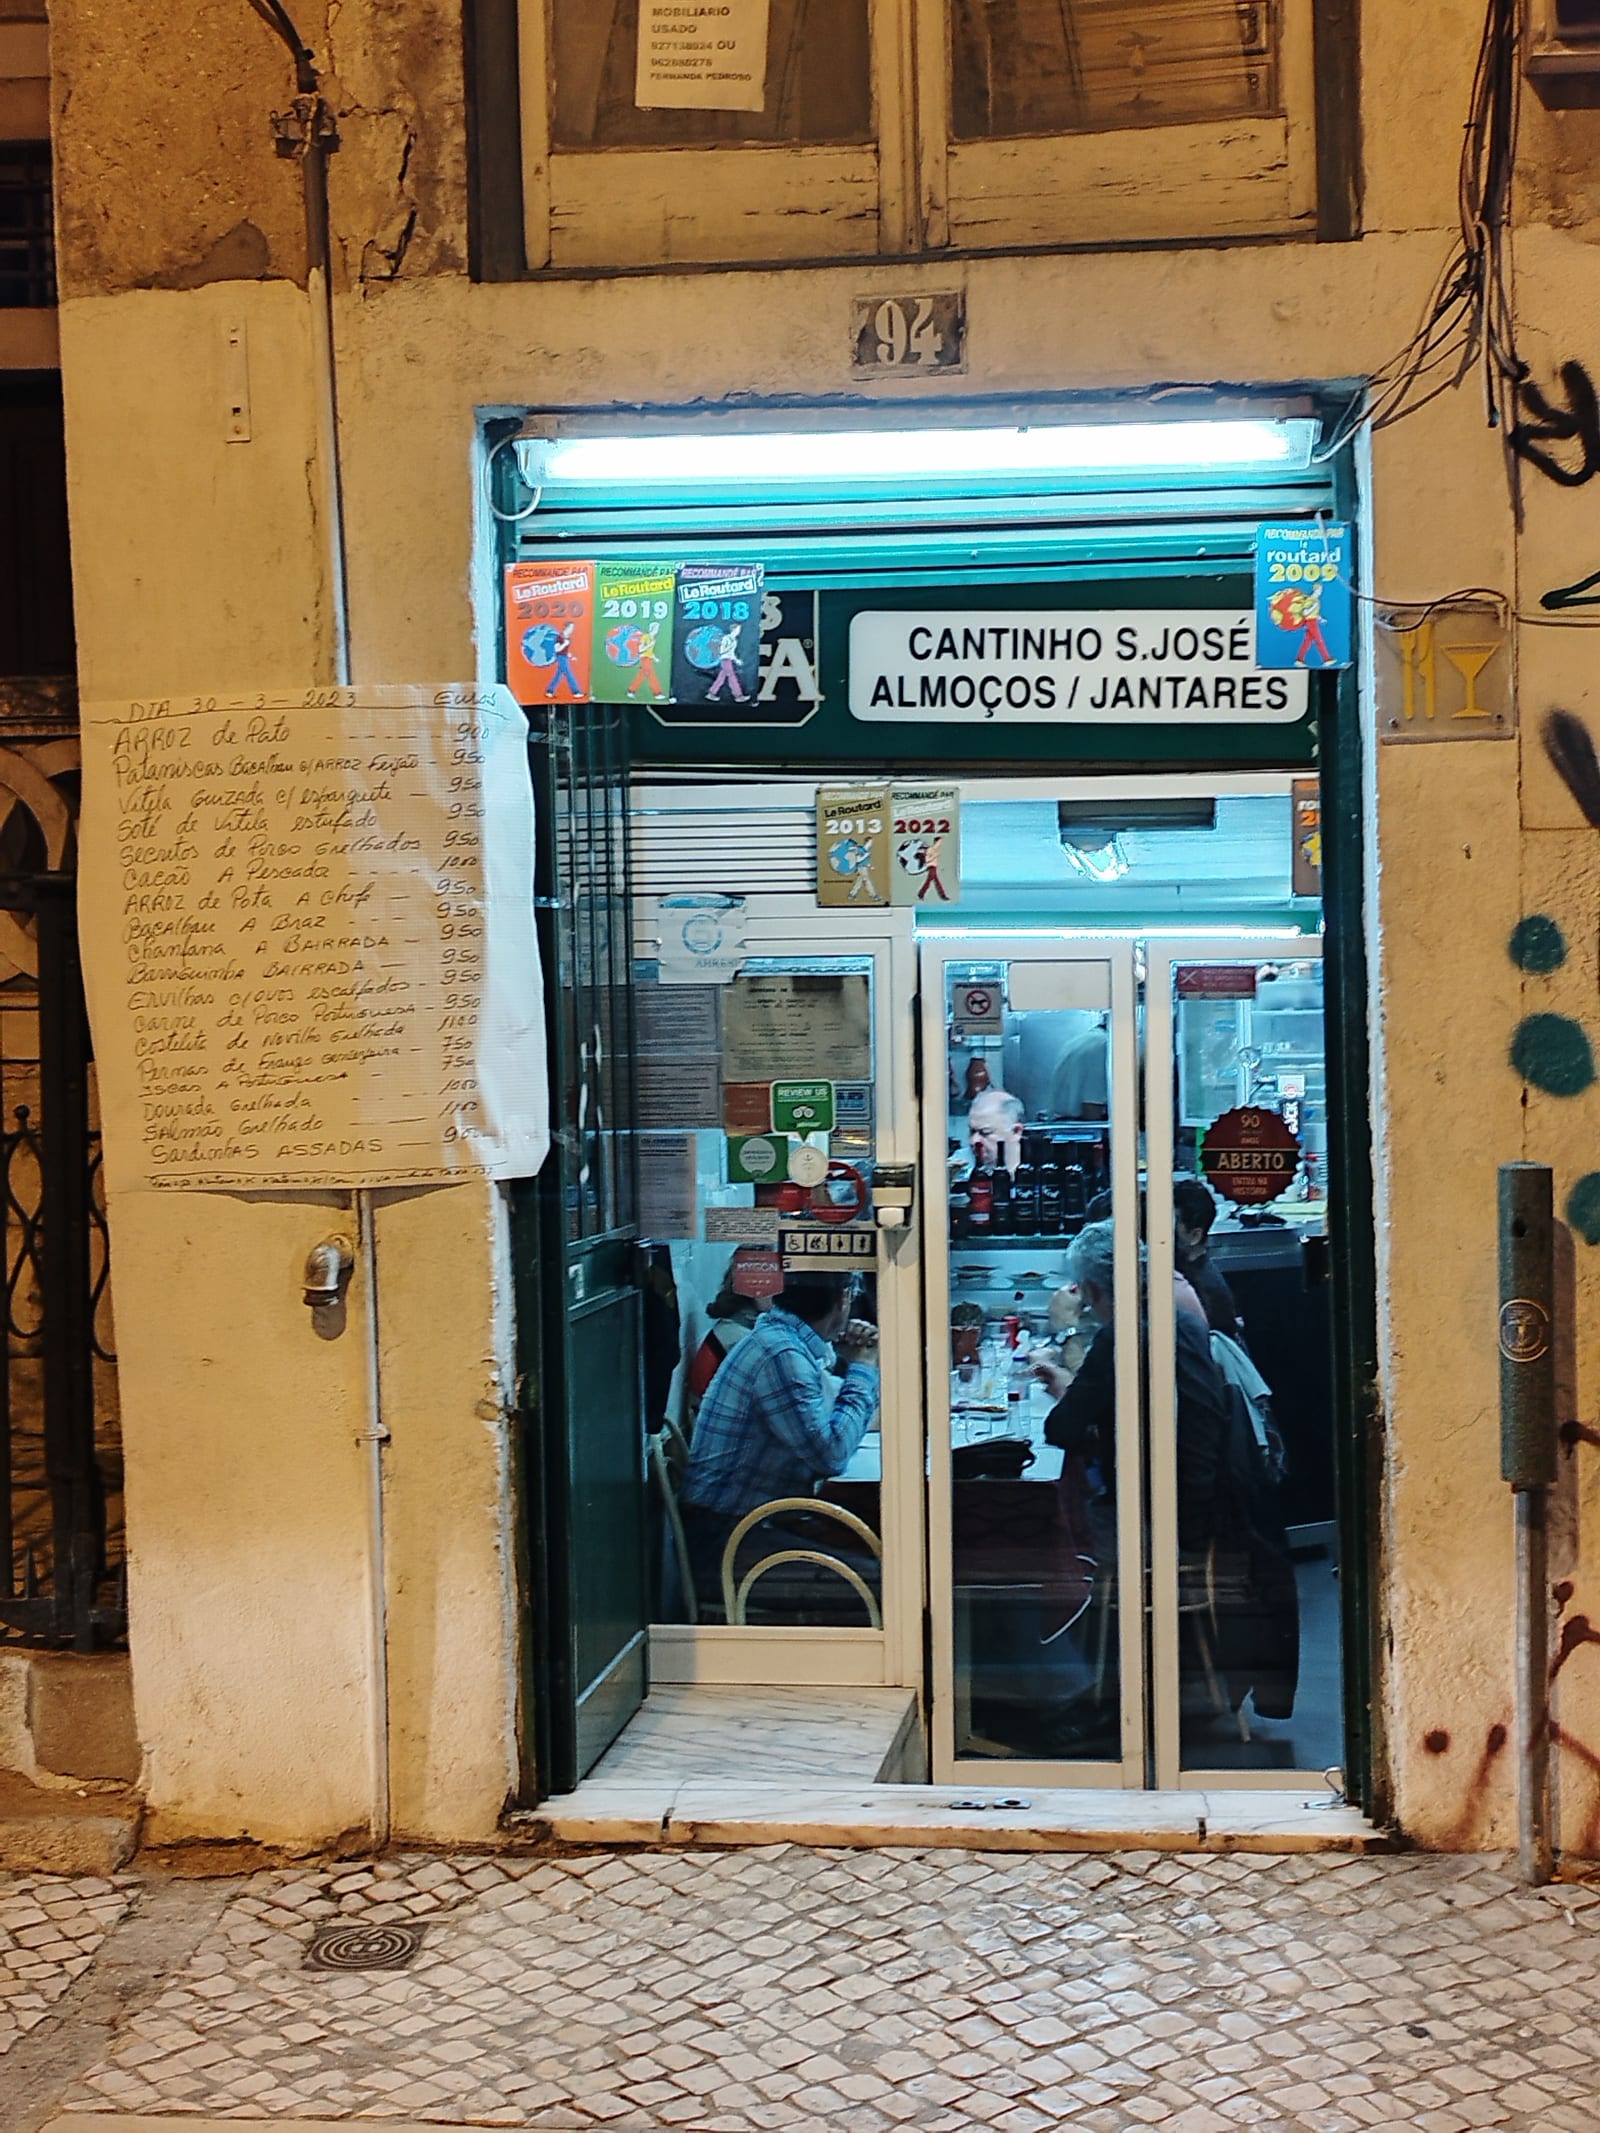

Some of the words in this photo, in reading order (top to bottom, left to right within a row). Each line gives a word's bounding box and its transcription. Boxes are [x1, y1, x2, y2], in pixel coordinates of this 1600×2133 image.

[652, 24, 697, 33] USADO
[717, 41, 736, 50] OU
[875, 298, 943, 366] 94
[1267, 548, 1341, 563] routard
[1268, 563, 1338, 582] 2009
[517, 601, 584, 619] 2020
[602, 600, 668, 618] 2019
[683, 601, 749, 620] 2018
[909, 627, 1101, 661] CANTINHO
[1116, 618, 1250, 661] S.JOSÉ
[870, 675, 1055, 717] ALMOÇOS
[1068, 677, 1080, 709] /
[1090, 676, 1288, 709] JANTARES
[129, 701, 170, 721] DIA
[189, 697, 217, 715] 30
[255, 693, 265, 711] 3
[302, 690, 356, 708] 2023
[114, 727, 192, 754] ARROZ
[212, 719, 238, 746] de
[245, 715, 290, 744] Pato
[176, 811, 198, 835] de
[826, 818, 882, 834] 2013
[894, 819, 950, 833] 2022
[214, 836, 236, 859] de
[198, 889, 220, 910] de
[239, 917, 256, 933] A
[216, 1009, 244, 1028] de
[226, 1032, 248, 1050] de
[222, 1057, 245, 1074] de
[778, 1088, 813, 1096] REVIEW
[815, 1087, 828, 1095] US
[1241, 1114, 1260, 1128] 90
[276, 1139, 383, 1159] ASSADAS
[1217, 1153, 1285, 1170] ABERTO
